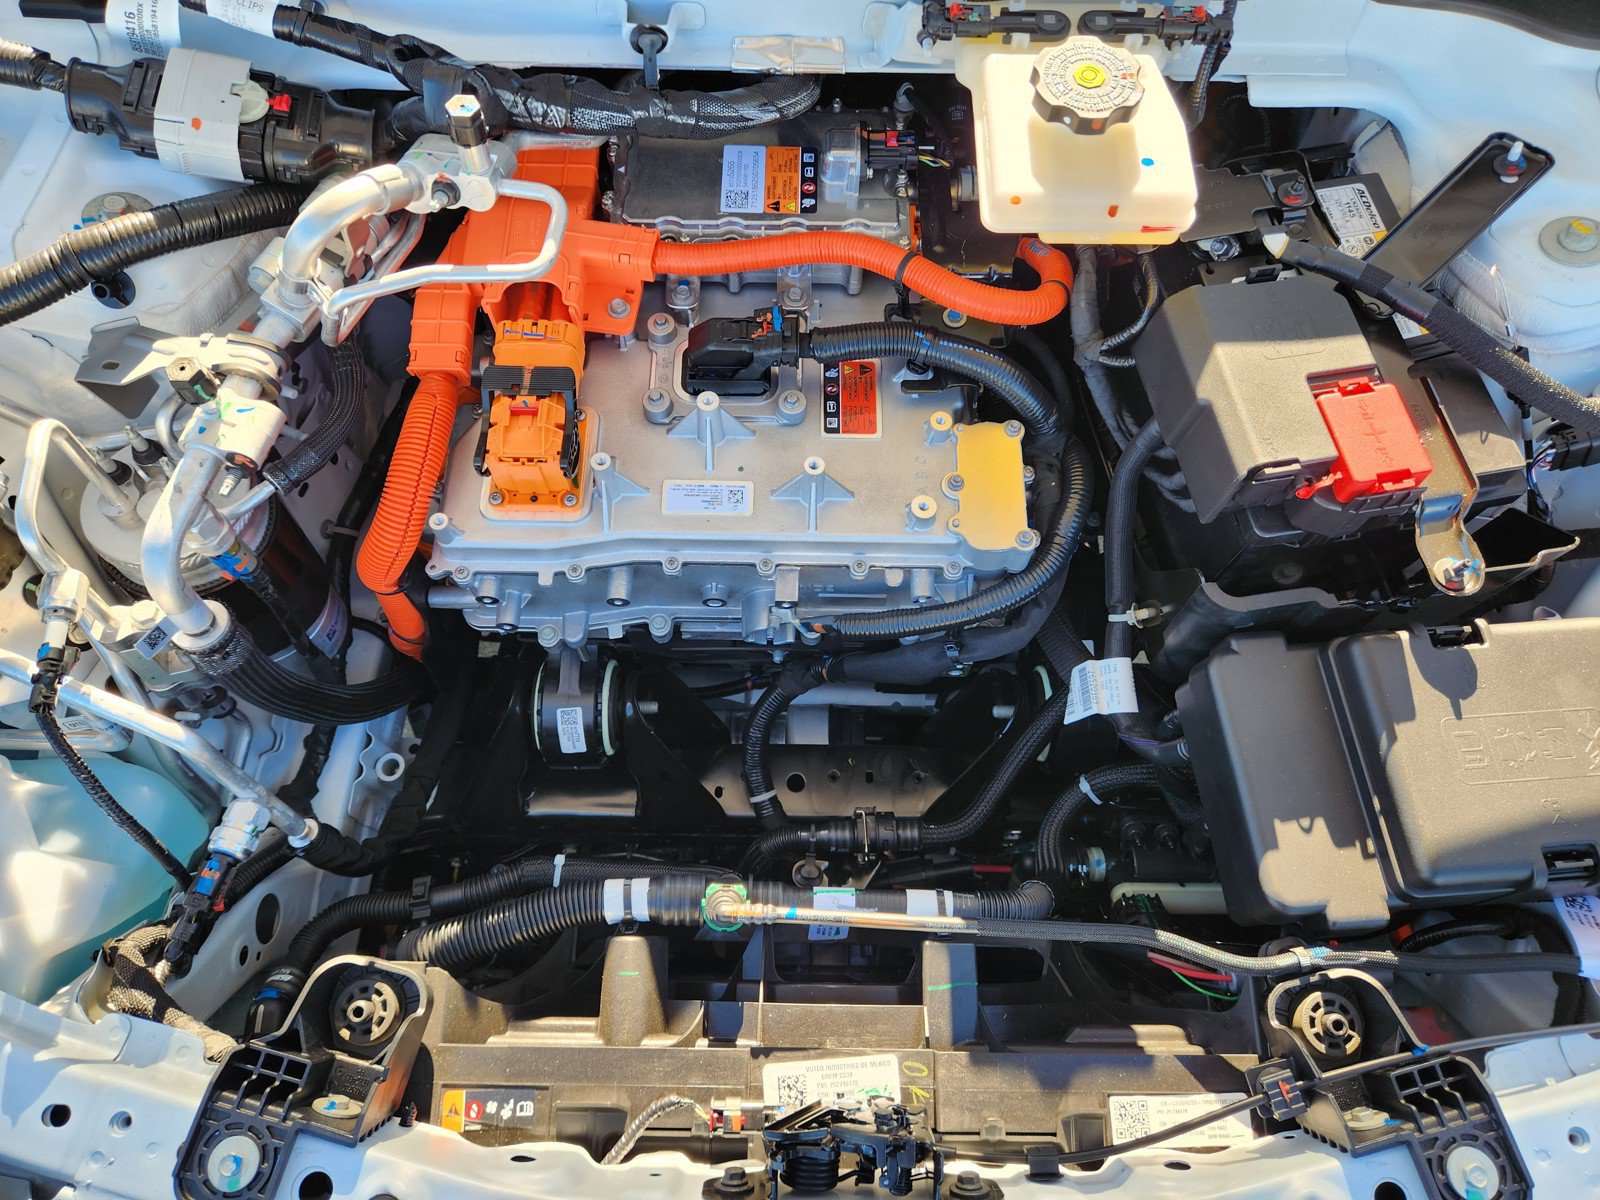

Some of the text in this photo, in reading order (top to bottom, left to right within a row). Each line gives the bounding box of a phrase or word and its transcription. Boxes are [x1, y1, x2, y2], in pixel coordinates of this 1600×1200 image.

[236, 0, 264, 13] CLIPS
[1344, 201, 1356, 218] 1145
[1356, 188, 1380, 229] ACDelco
[805, 1060, 892, 1073] VUTEQ INDUSTRIES DE MEXICO
